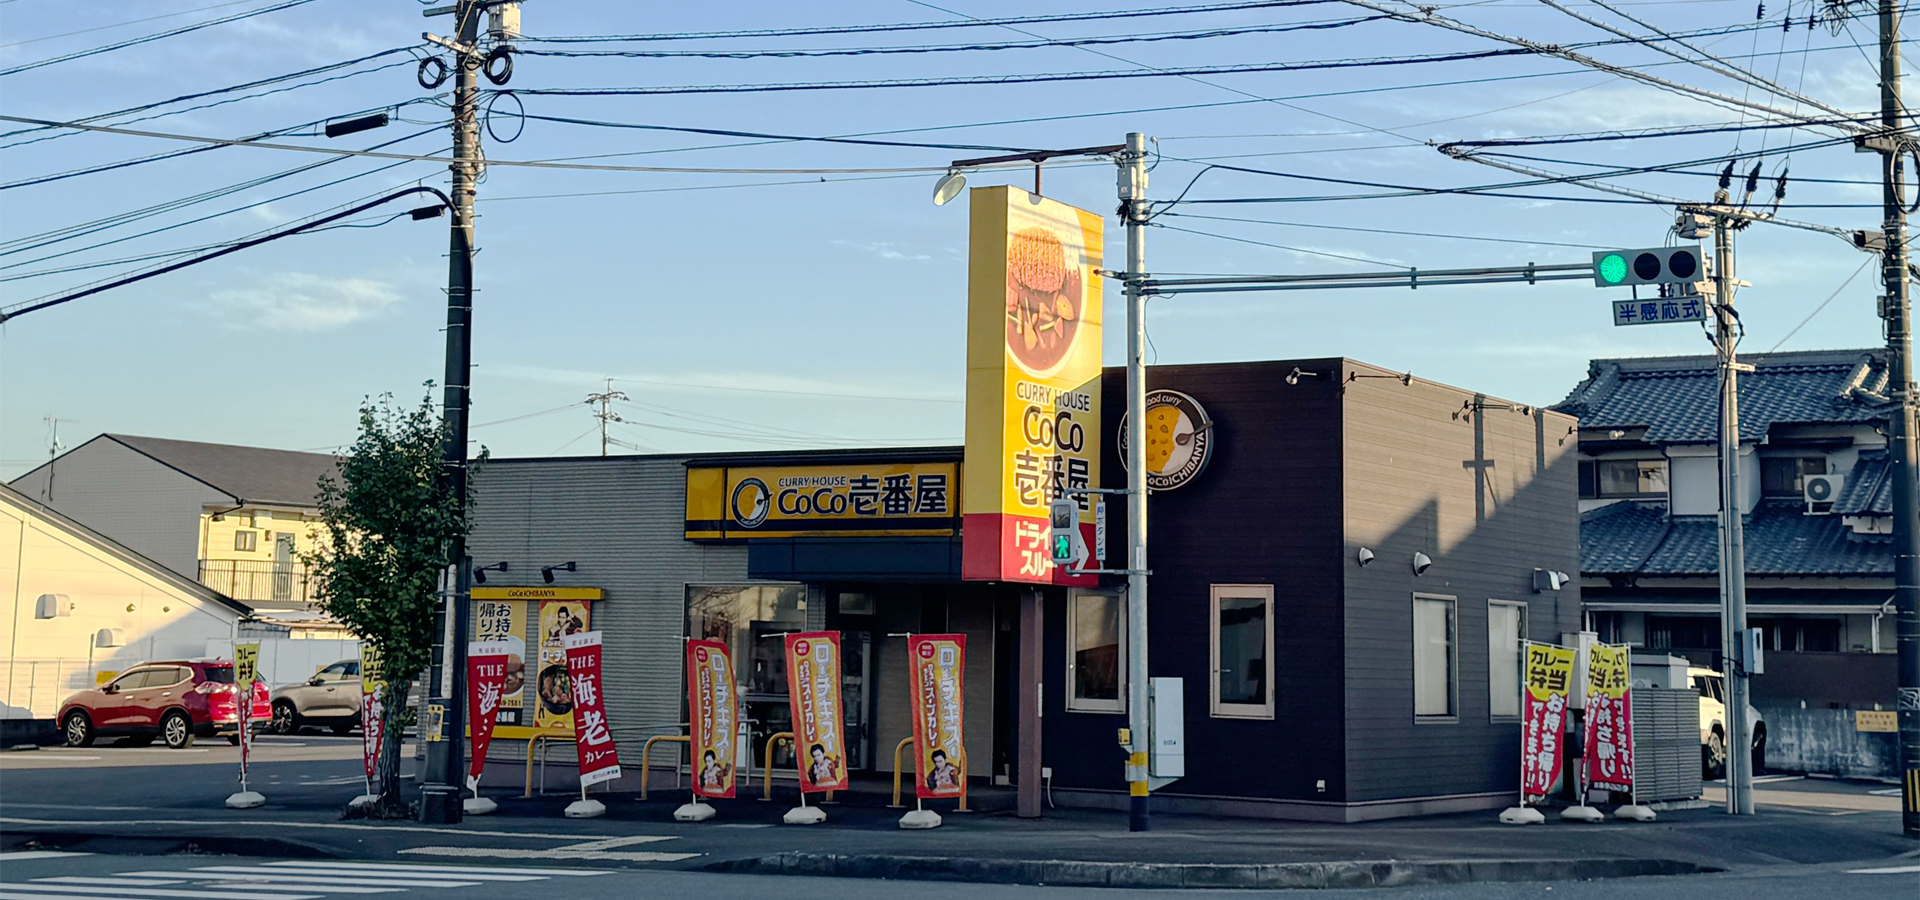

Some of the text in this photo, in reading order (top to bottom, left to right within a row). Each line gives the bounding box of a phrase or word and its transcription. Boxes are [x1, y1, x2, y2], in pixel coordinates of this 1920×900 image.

[1619, 301, 1701, 322] 半感応式
[1016, 382, 1090, 411] CURRY HOUSE
[1161, 395, 1182, 407] curry
[1024, 405, 1084, 453] CoCo
[1147, 432, 1205, 486] oCoICHIBANYA
[778, 476, 846, 487] CURRY HOUSE
[1015, 449, 1089, 511] 壱番屋
[777, 474, 947, 515] CoCo壱番屋
[508, 589, 556, 598] CoCoICHIBANYA
[569, 654, 595, 670] THE
[1531, 651, 1569, 666] カレー
[1530, 666, 1567, 691] 弁当
[571, 673, 611, 746] 海老
[1538, 692, 1565, 791] お持ち帰り
[585, 749, 615, 765] カレー
